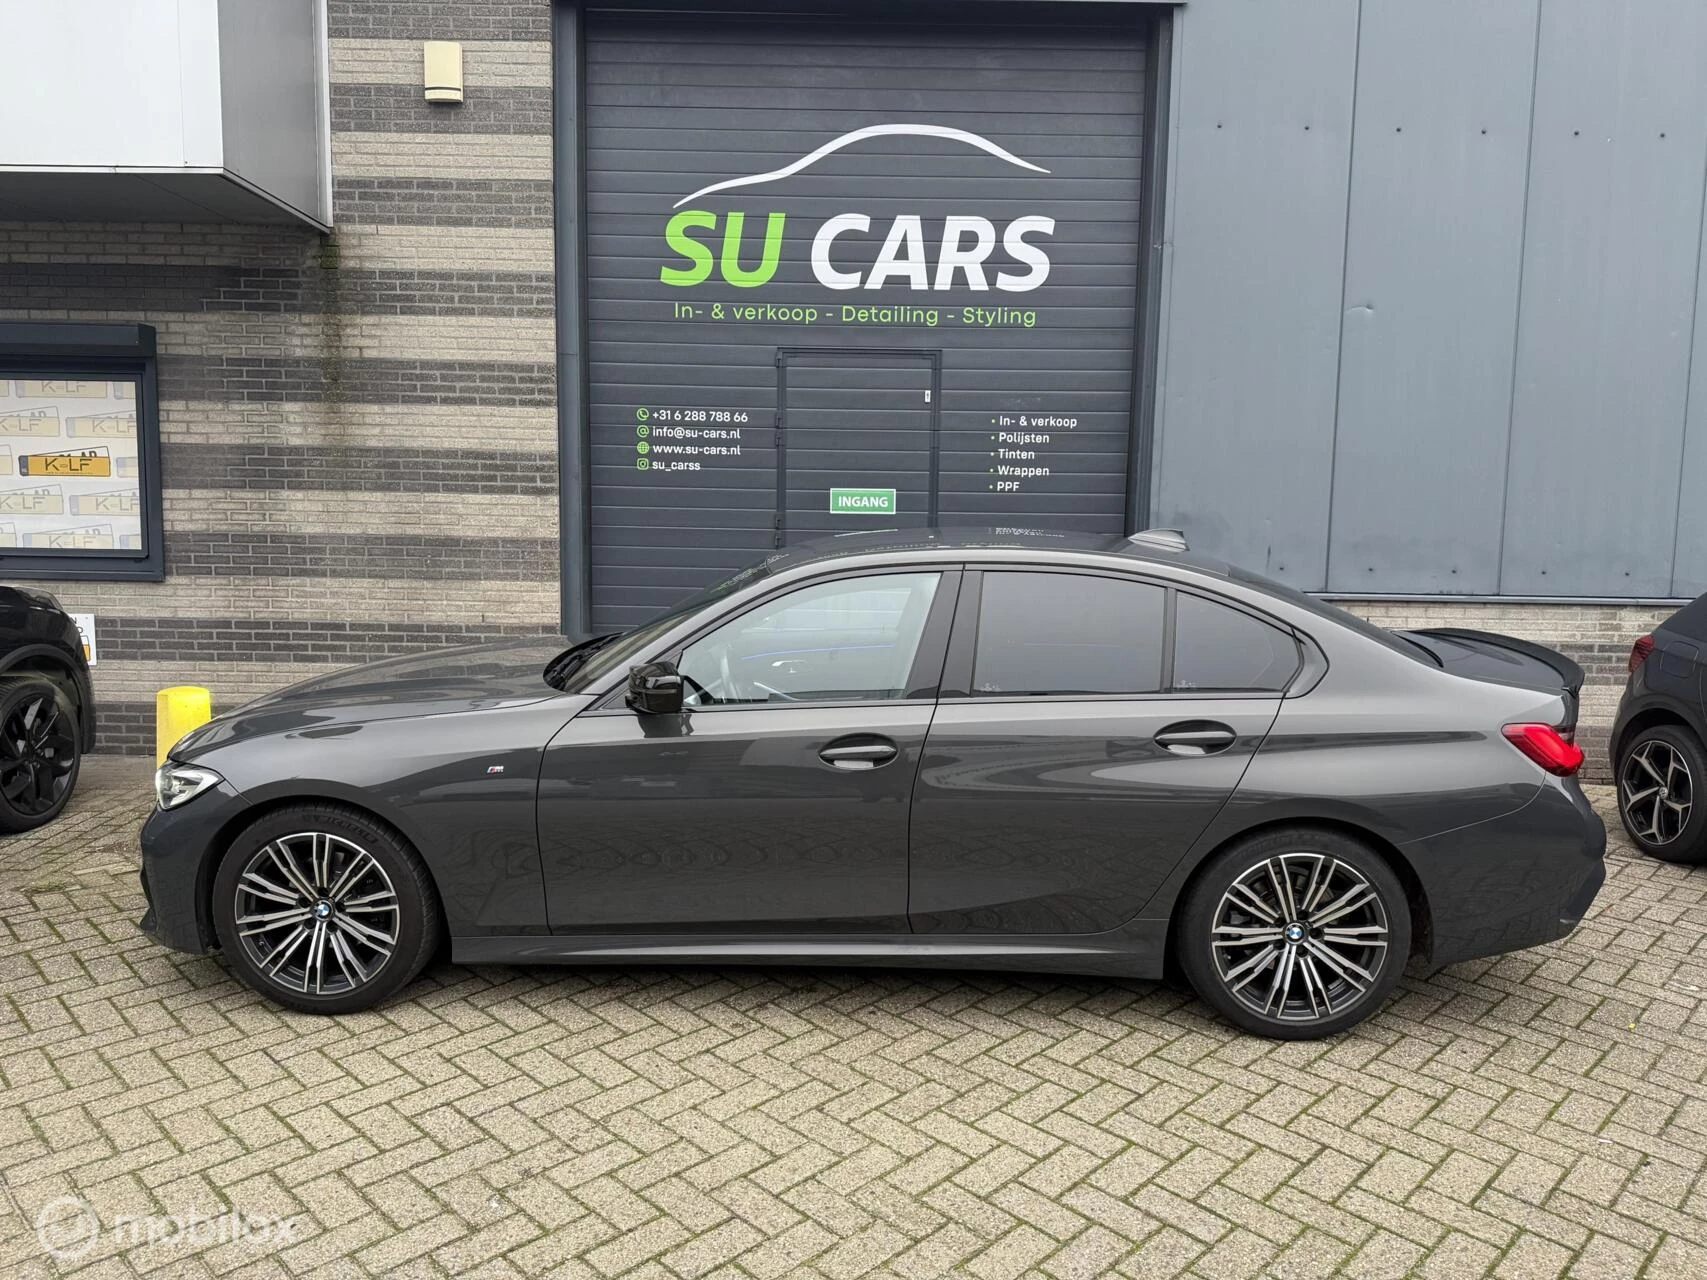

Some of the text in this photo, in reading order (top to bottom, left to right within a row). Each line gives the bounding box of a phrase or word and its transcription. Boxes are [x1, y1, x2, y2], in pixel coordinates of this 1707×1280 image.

[660, 210, 1056, 292] SU CARS
[674, 303, 703, 319] In-
[711, 303, 725, 320] &
[732, 304, 817, 324] verkoop
[842, 306, 938, 327] Detailing
[963, 307, 1036, 327] Styling
[652, 410, 748, 422] +31 6 288 788 66
[1000, 416, 1078, 429] In- & verkoop
[652, 426, 741, 439] info@su-cars.nl
[998, 432, 1050, 445] Polijsten
[652, 443, 741, 456] www.su-cars.nl
[998, 448, 1035, 460] Tinten
[652, 460, 701, 472] su_carss
[998, 464, 1050, 478] Wrappen
[997, 481, 1020, 492] PPF
[838, 495, 889, 508] INGANG
